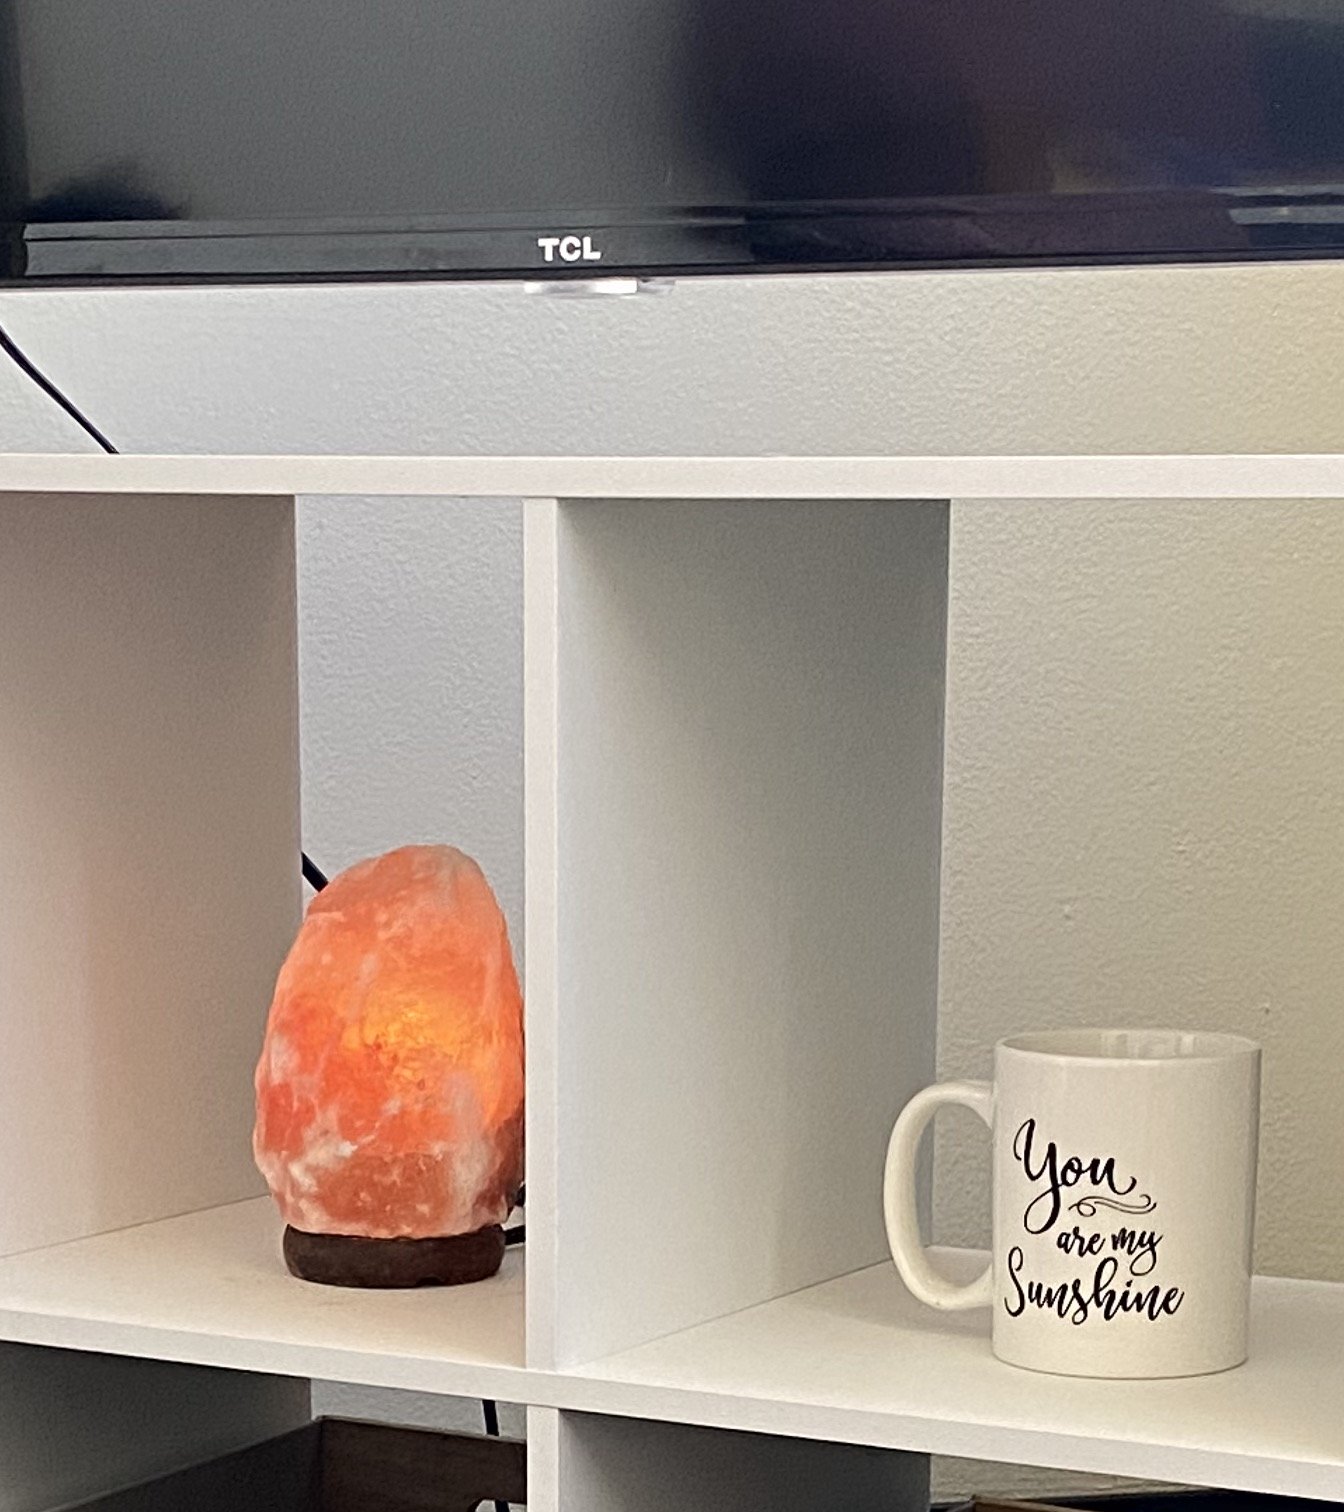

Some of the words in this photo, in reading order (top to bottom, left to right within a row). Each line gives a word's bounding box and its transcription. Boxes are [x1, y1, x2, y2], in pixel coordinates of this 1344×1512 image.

[537, 235, 602, 262] TCL
[1013, 1118, 1137, 1234] You
[1056, 1226, 1106, 1257] are
[1111, 1226, 1163, 1276] my
[1004, 1246, 1185, 1325] Sunshine
